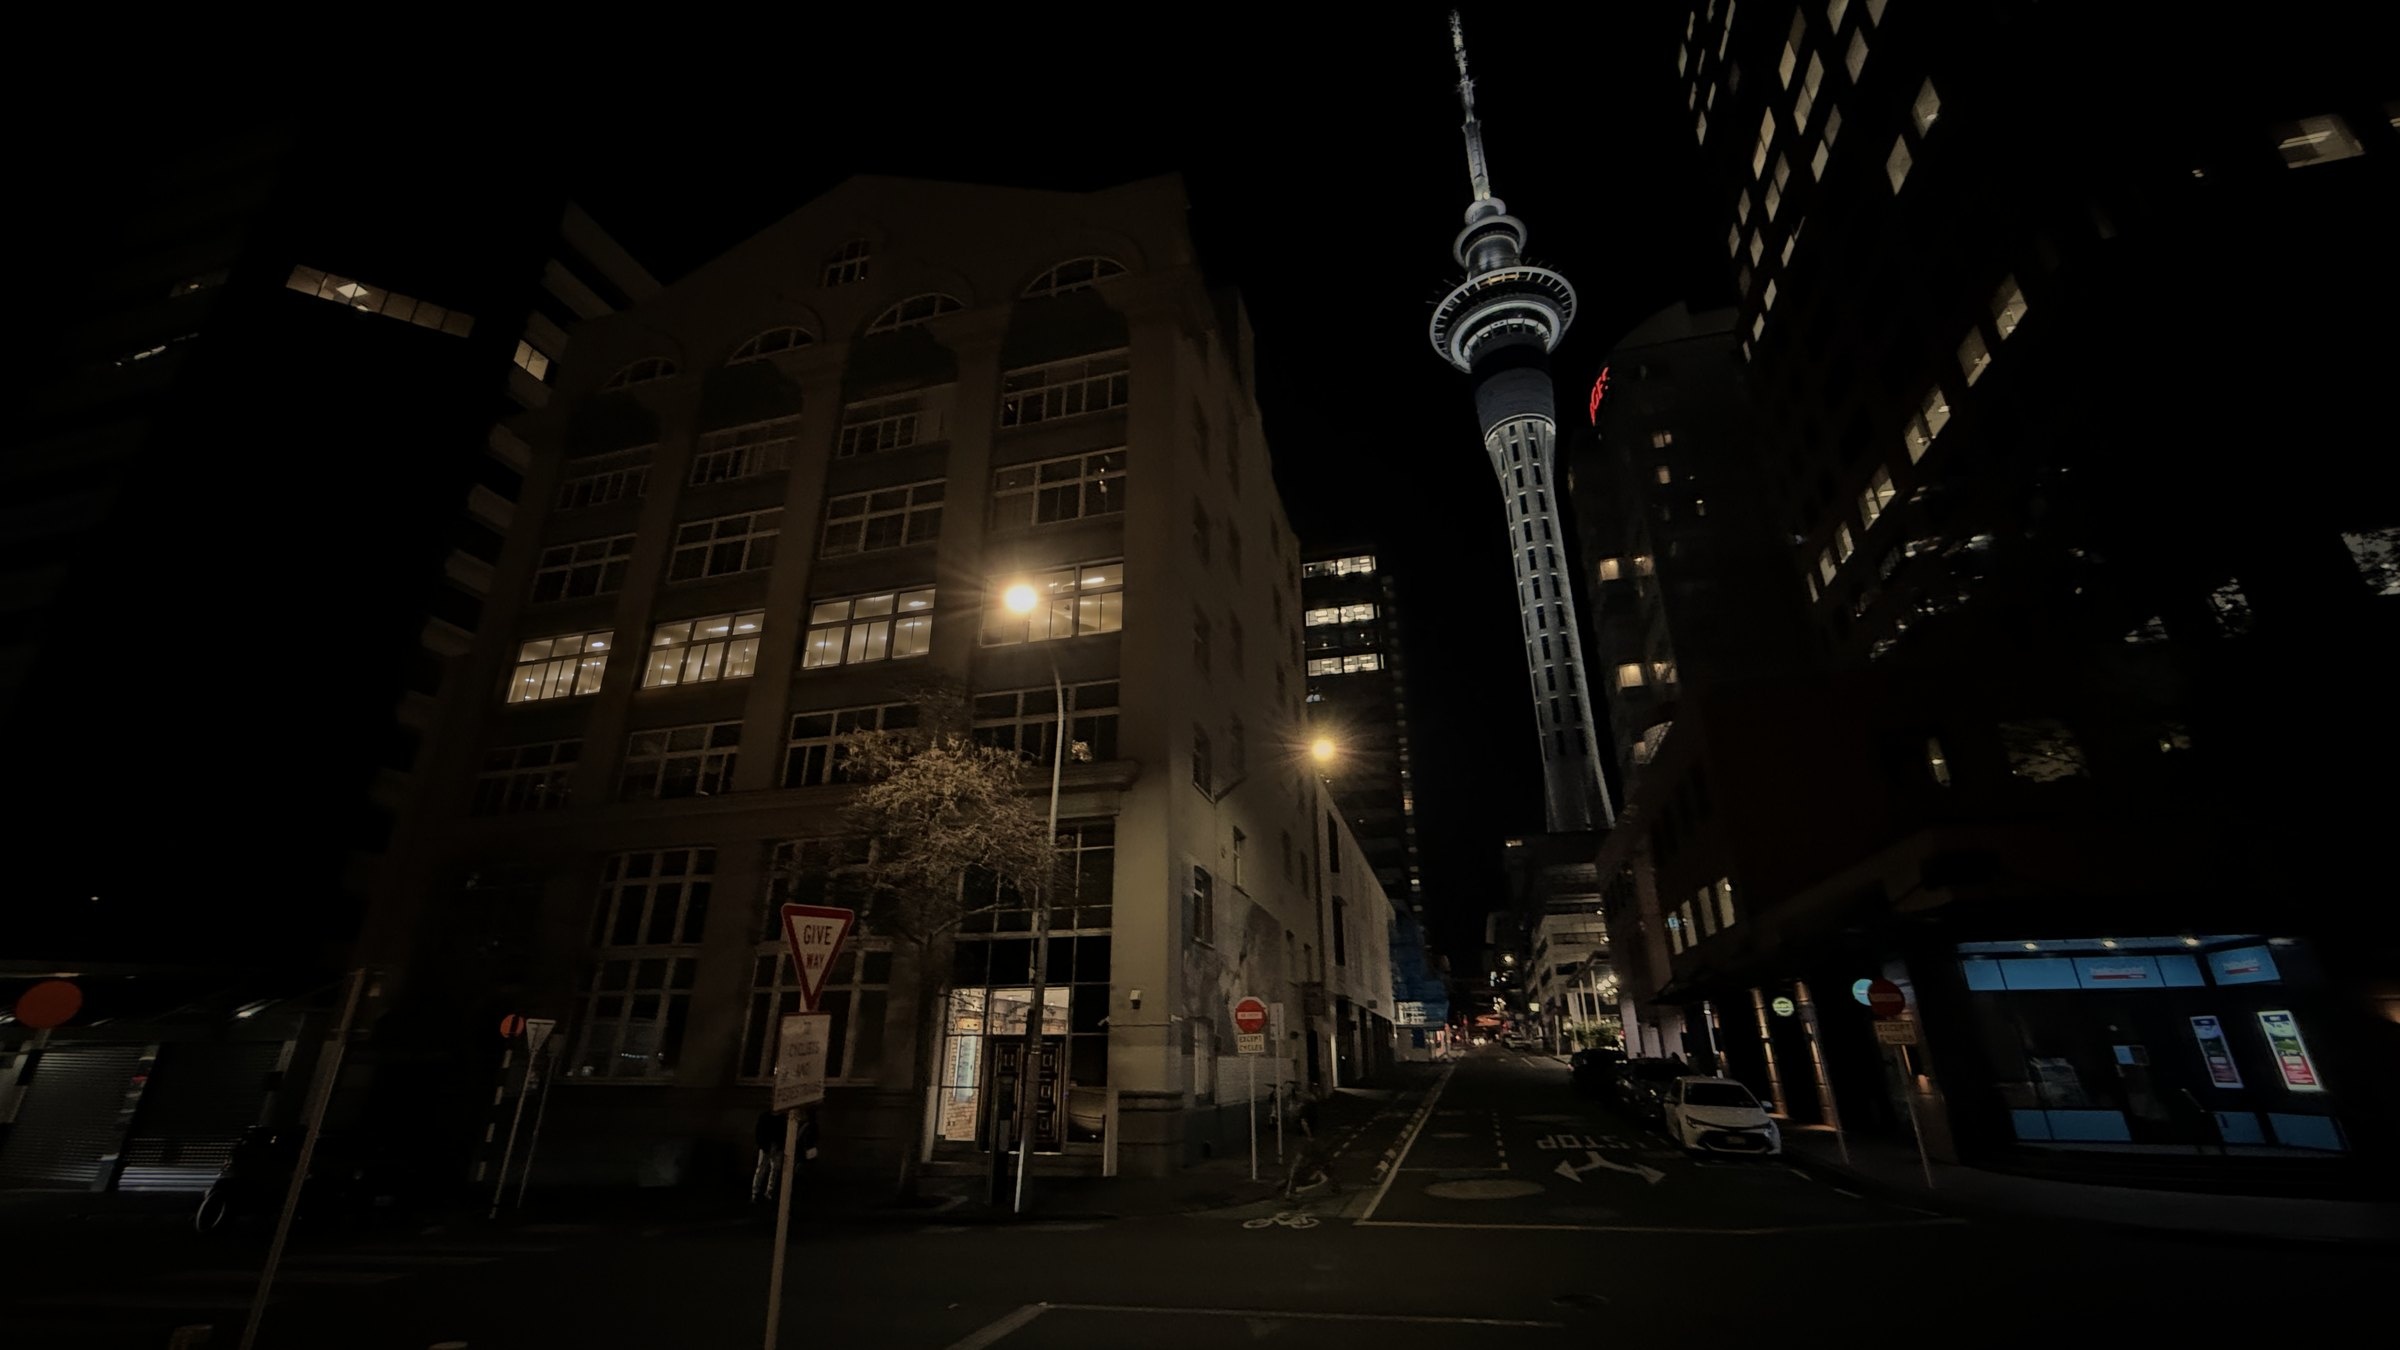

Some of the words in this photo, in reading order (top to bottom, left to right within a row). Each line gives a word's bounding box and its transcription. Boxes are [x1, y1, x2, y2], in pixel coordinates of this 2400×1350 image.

[803, 924, 833, 945] GIVE
[806, 952, 826, 970] WAY
[1535, 1134, 1631, 1150] STOP
